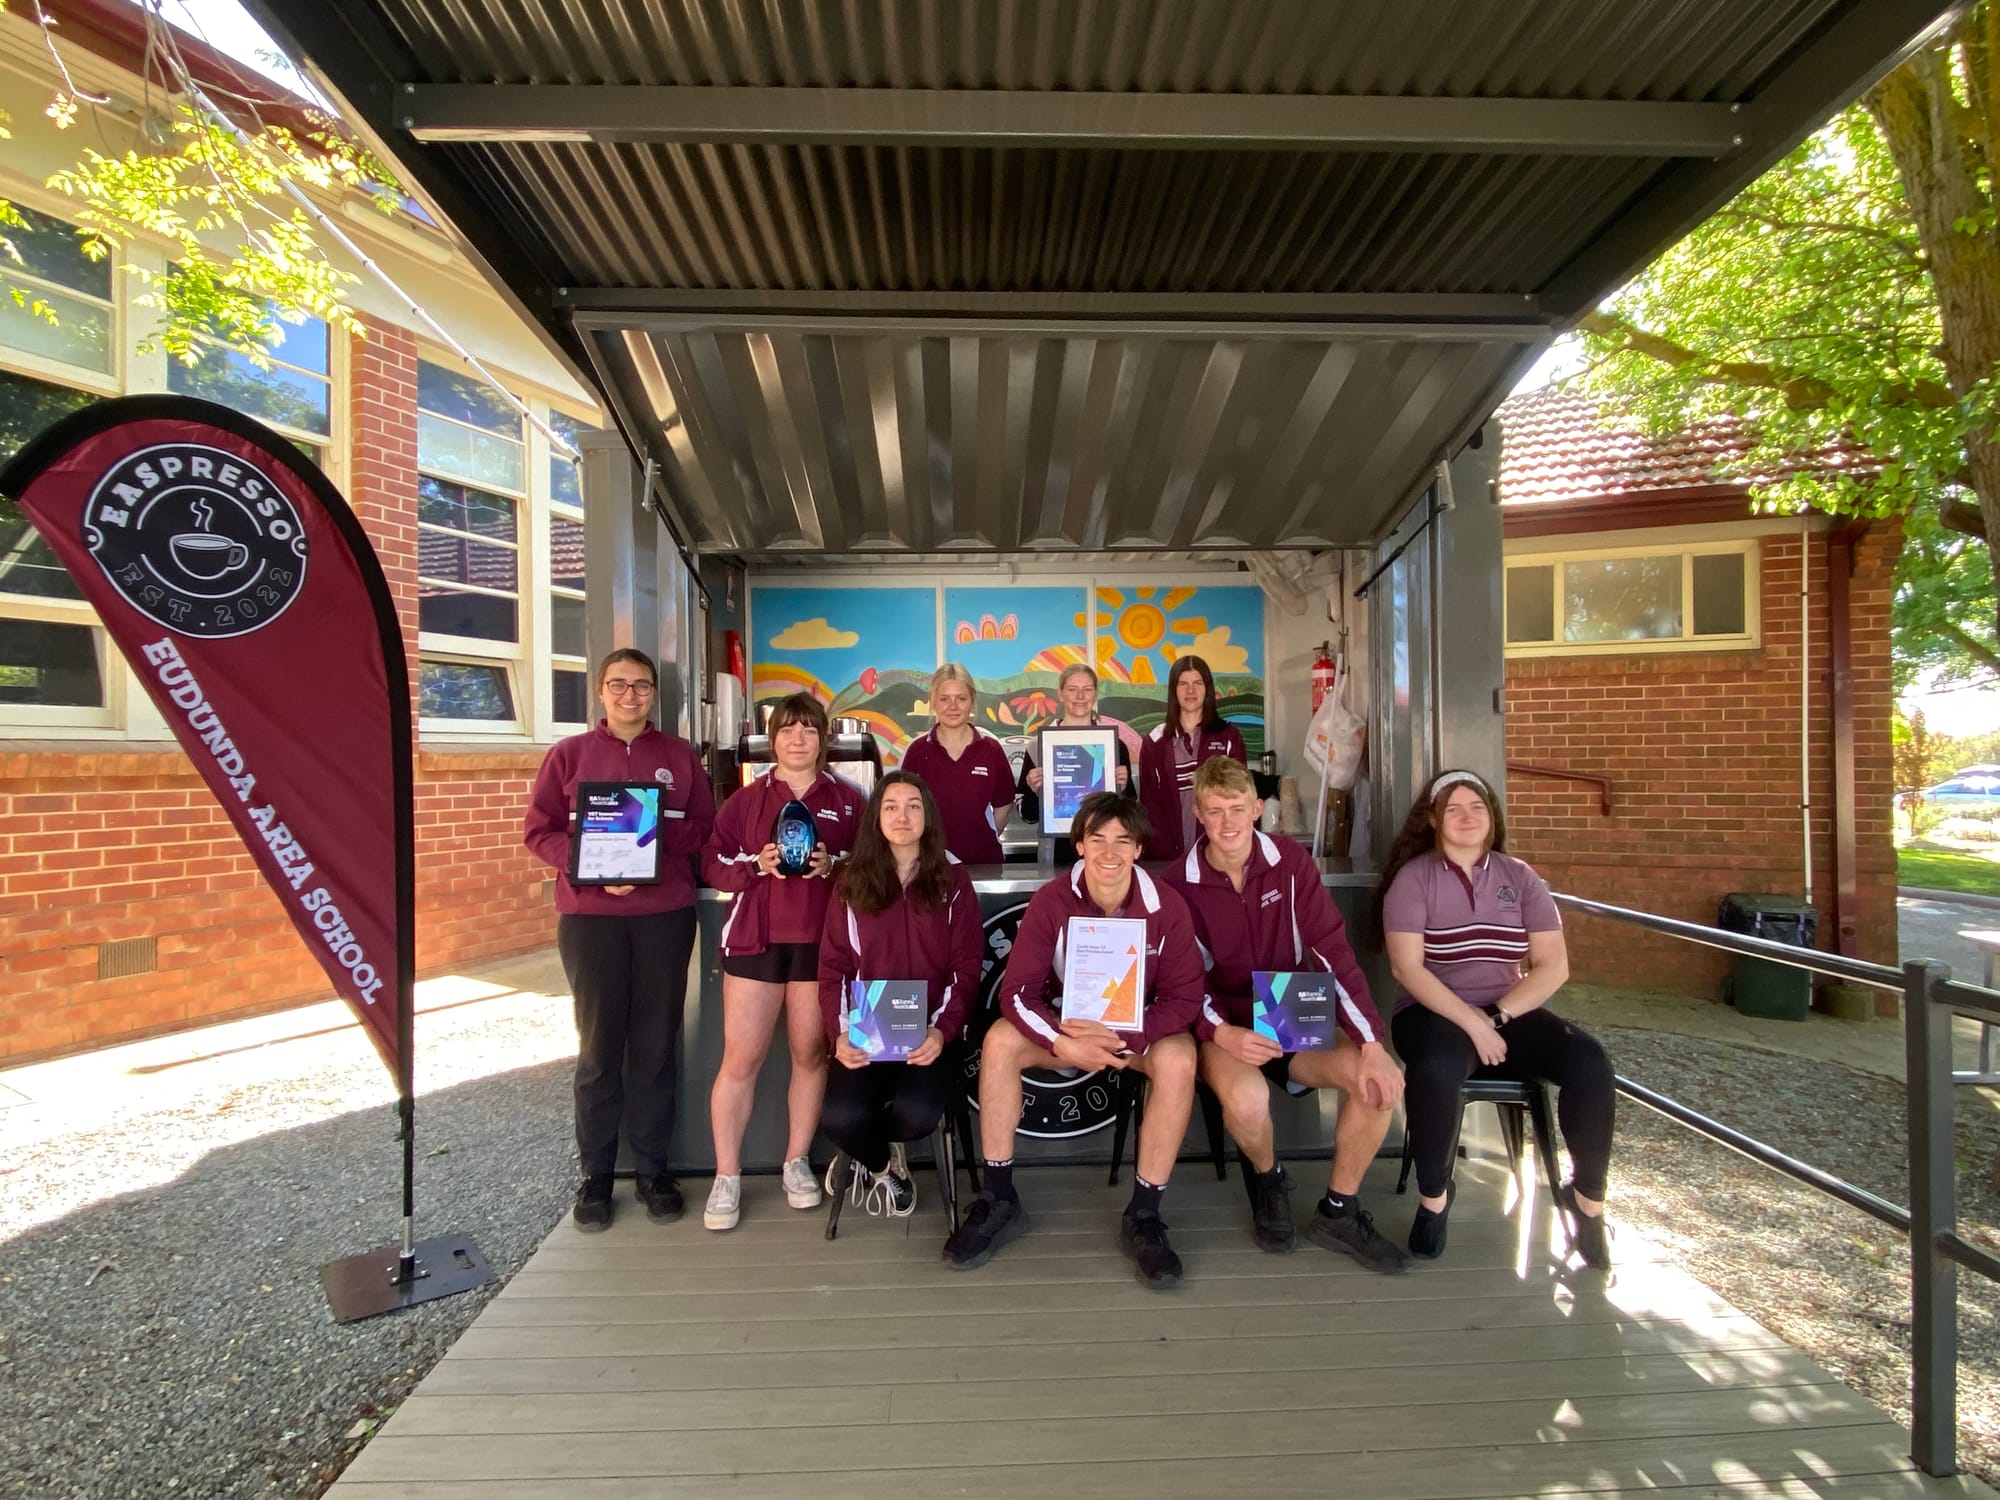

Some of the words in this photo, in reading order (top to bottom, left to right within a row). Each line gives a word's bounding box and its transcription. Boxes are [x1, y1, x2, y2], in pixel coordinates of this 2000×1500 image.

[100, 456, 292, 542] EASPRESSO
[215, 566, 293, 627] 2022
[142, 637, 258, 801] EUDUNDA
[248, 804, 315, 891] AREA
[300, 887, 385, 1005] SCHOOL
